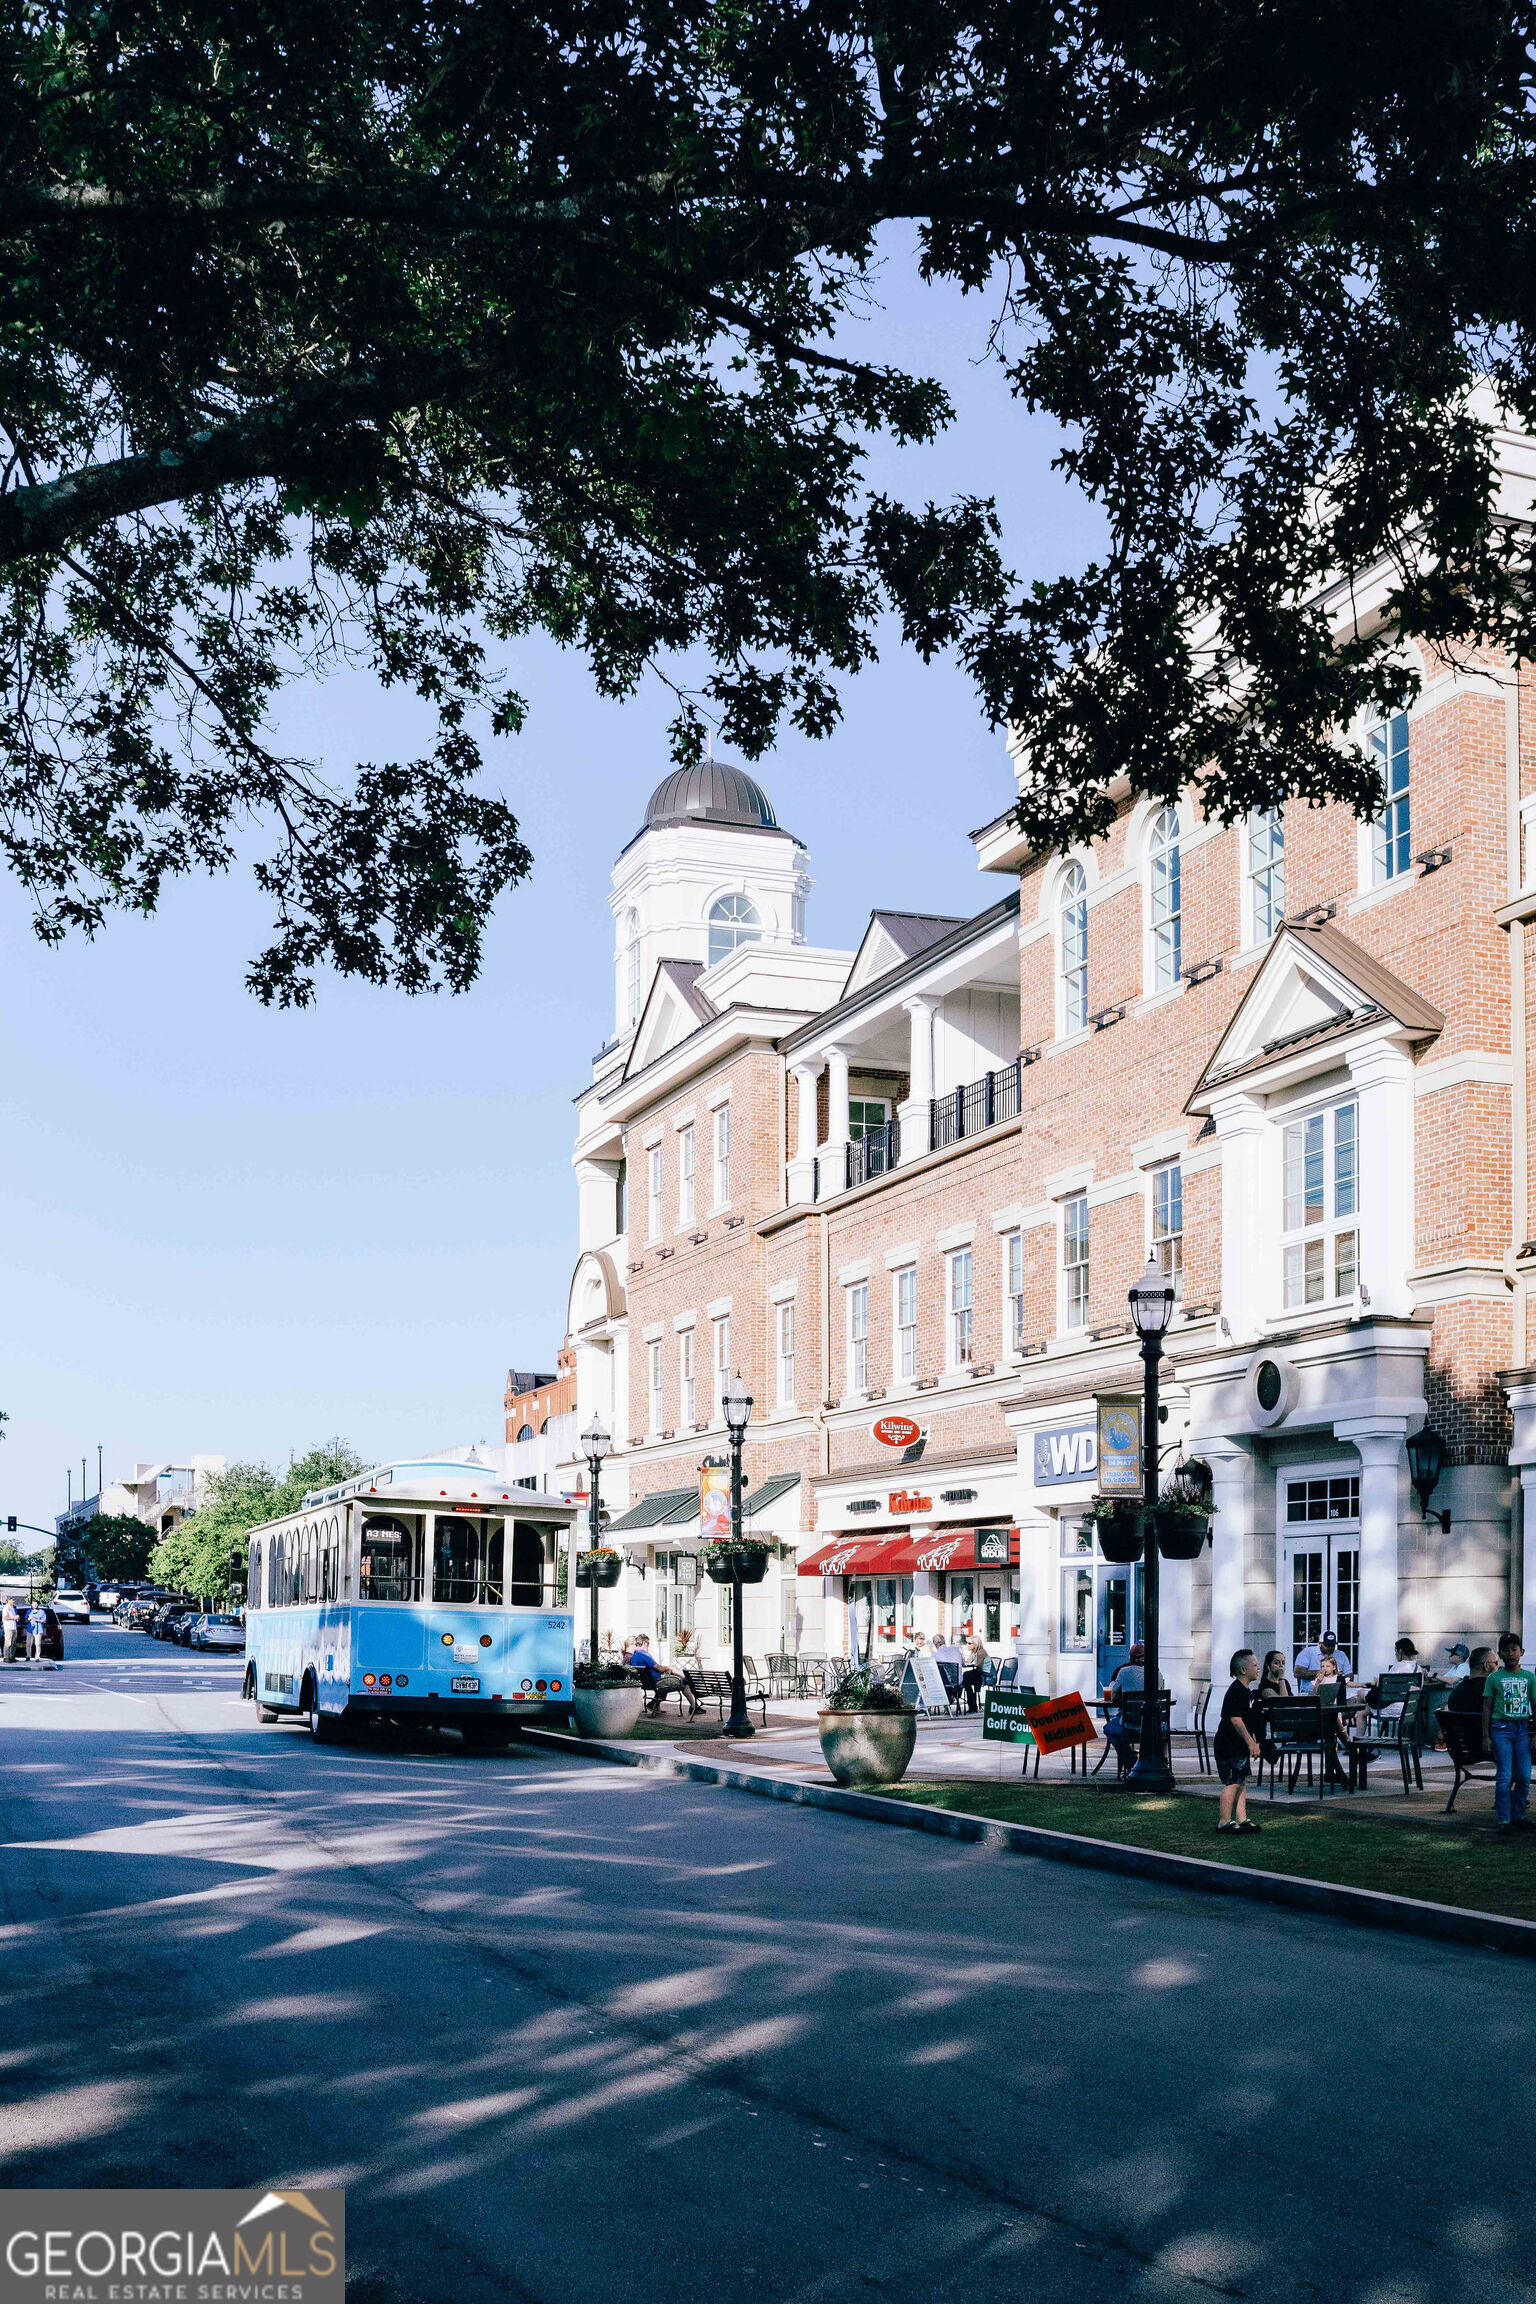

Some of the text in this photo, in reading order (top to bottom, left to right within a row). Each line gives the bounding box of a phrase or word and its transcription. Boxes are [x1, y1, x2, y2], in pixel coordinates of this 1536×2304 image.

[881, 1420, 913, 1431] Kilwins
[1330, 1509, 1339, 1517] 106
[981, 1550, 1007, 1558] WDUN
[548, 1621, 566, 1630] 5242
[1030, 1704, 1085, 1728] Downtown
[987, 1717, 1007, 1730] Golf
[1043, 1721, 1086, 1744] Midland
